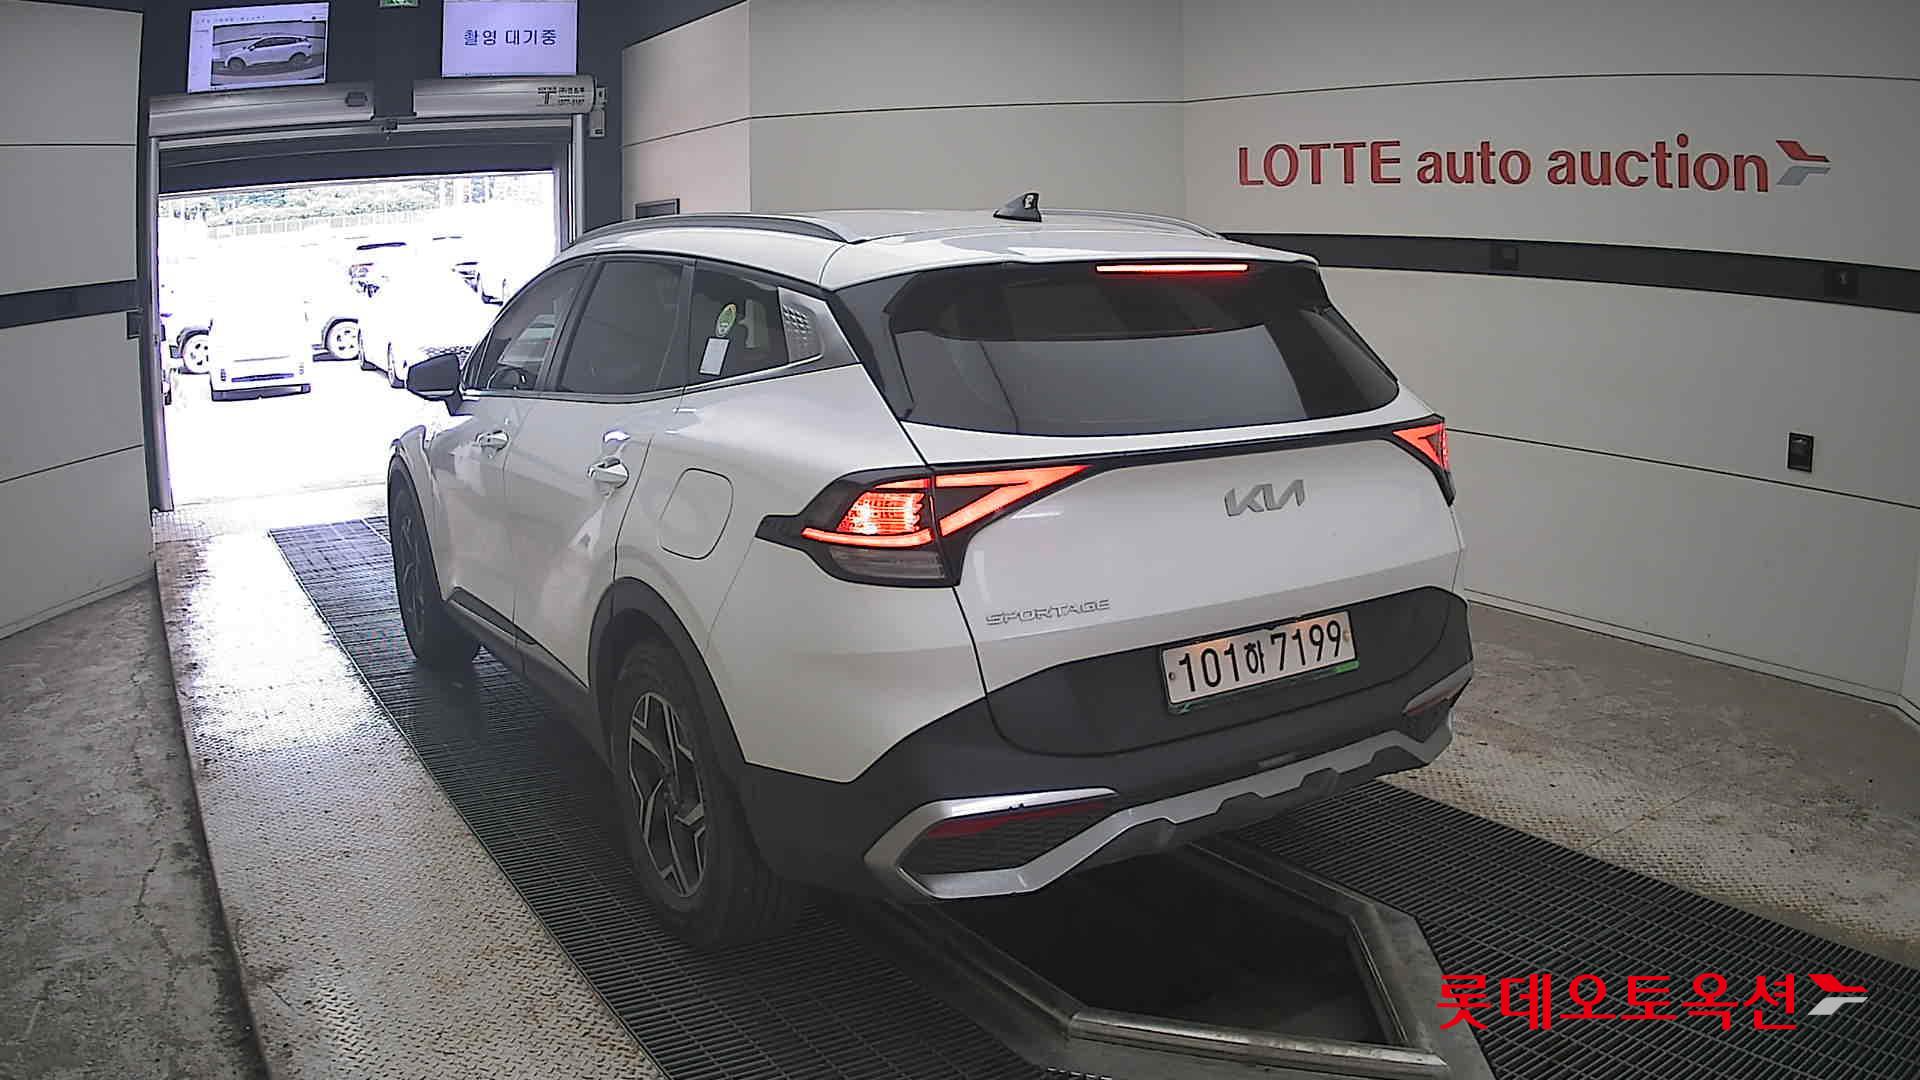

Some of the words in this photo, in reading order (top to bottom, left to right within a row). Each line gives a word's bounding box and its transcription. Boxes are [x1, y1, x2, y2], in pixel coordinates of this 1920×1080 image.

[464, 29, 497, 46] 촬영
[505, 29, 557, 46] 대기중
[1238, 140, 1401, 187] LOTTE
[1416, 141, 1531, 185] auto
[1547, 133, 1769, 193] auction
[1224, 479, 1305, 517] KIA
[985, 599, 1111, 626] SPORTAGE
